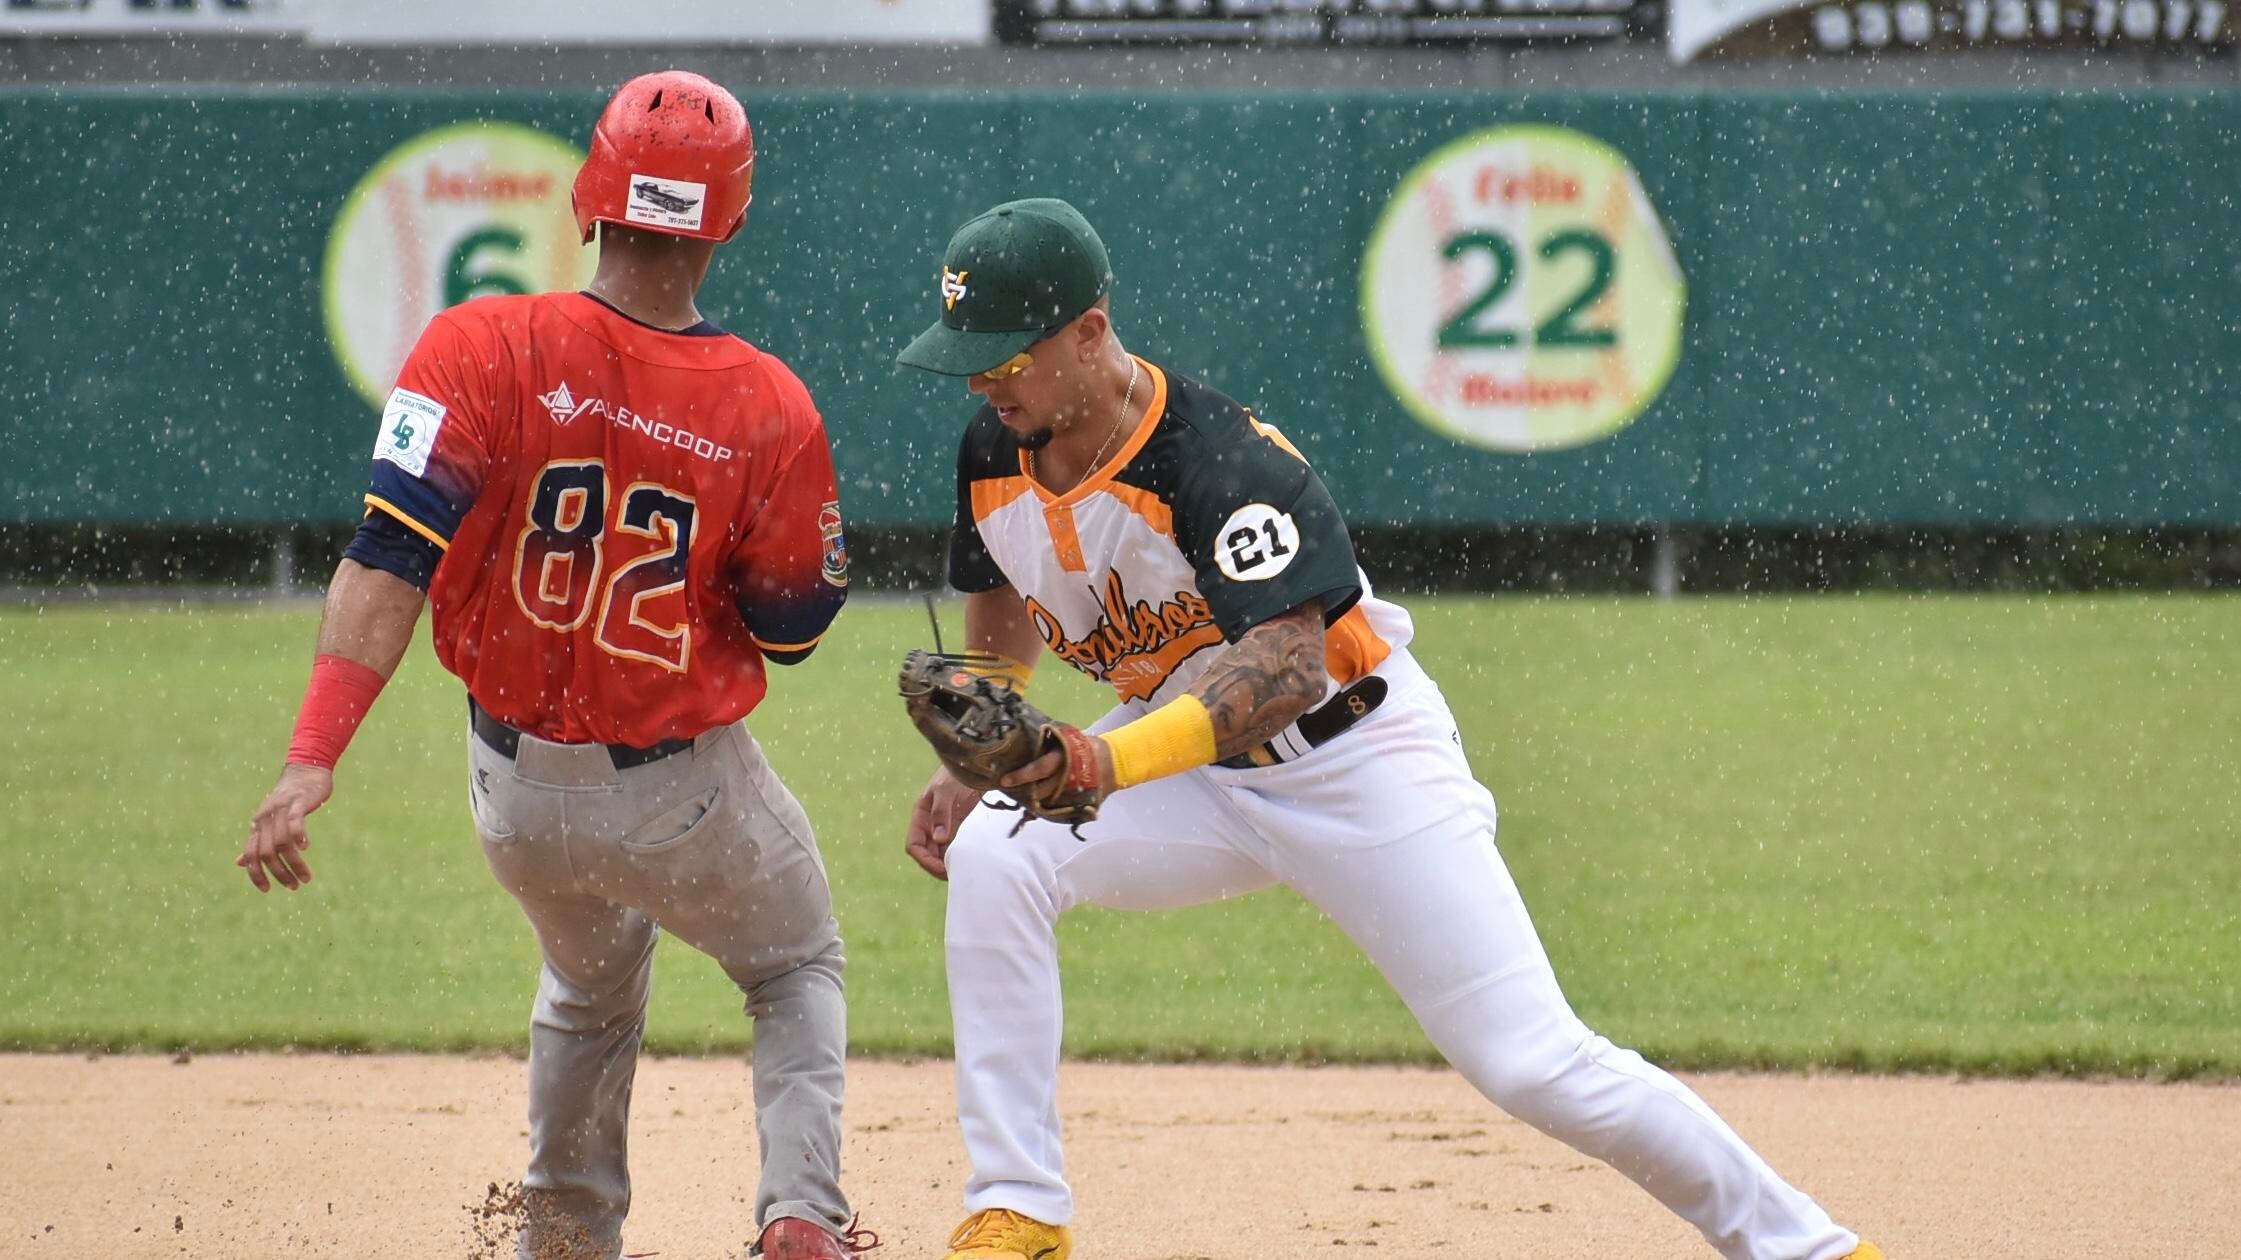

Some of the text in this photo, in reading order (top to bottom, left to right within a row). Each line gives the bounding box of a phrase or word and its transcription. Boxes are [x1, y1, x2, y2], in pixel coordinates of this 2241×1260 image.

[1438, 229, 1618, 345] 22
[512, 456, 700, 674] 82
[1227, 518, 1290, 573] 21
